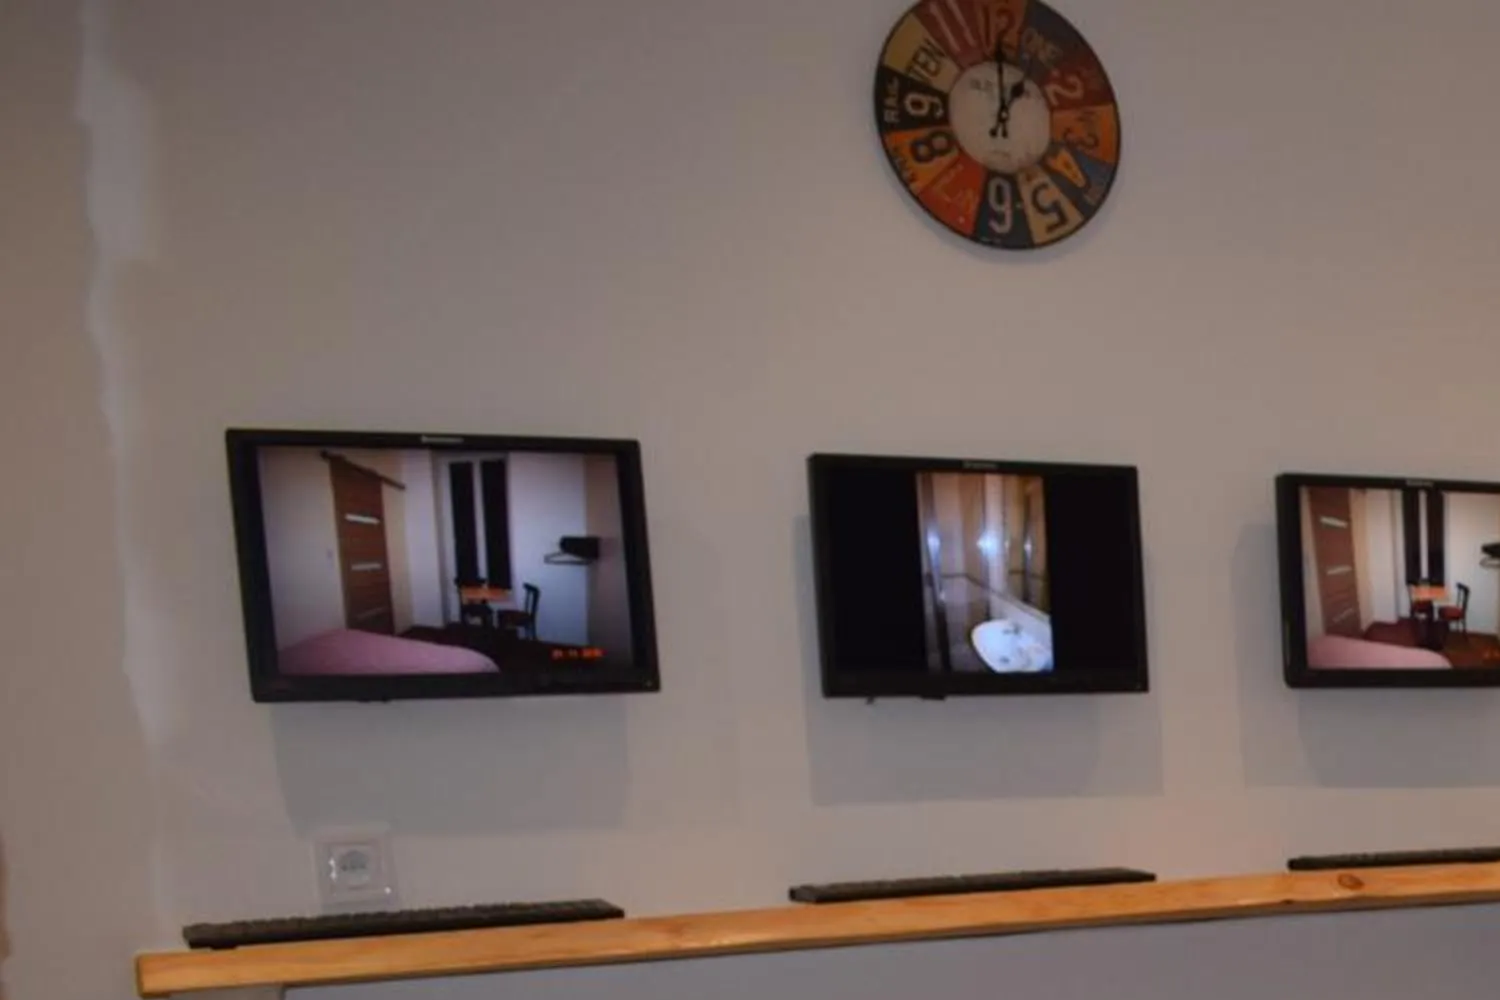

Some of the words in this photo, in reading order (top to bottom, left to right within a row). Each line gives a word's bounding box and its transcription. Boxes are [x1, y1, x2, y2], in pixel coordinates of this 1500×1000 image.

[905, 38, 947, 85] TEN
[904, 92, 945, 119] 9
[910, 130, 956, 163] 8
[1031, 182, 1069, 235] 5
